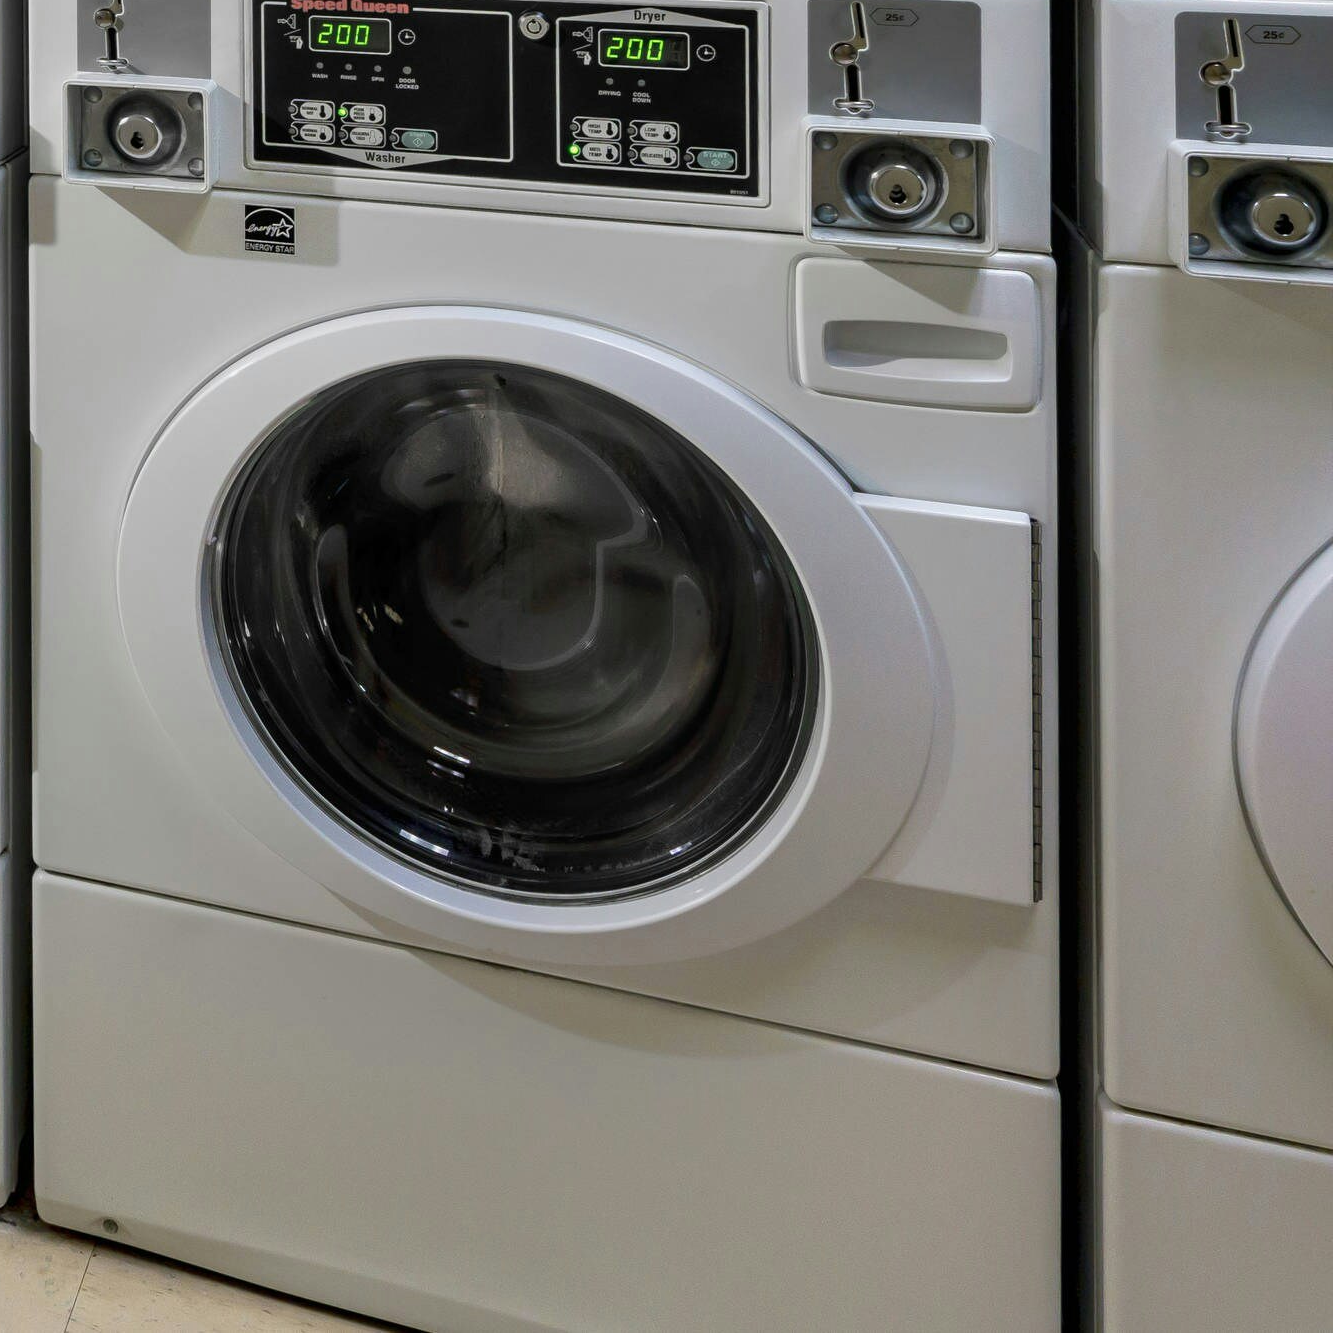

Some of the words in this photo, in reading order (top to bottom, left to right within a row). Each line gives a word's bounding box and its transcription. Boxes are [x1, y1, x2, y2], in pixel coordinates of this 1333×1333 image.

[634, 10, 666, 23] Dryer
[318, 24, 369, 45] 200
[606, 37, 664, 61] 200
[365, 152, 406, 164] Washer
[245, 243, 274, 252] ENERGY
